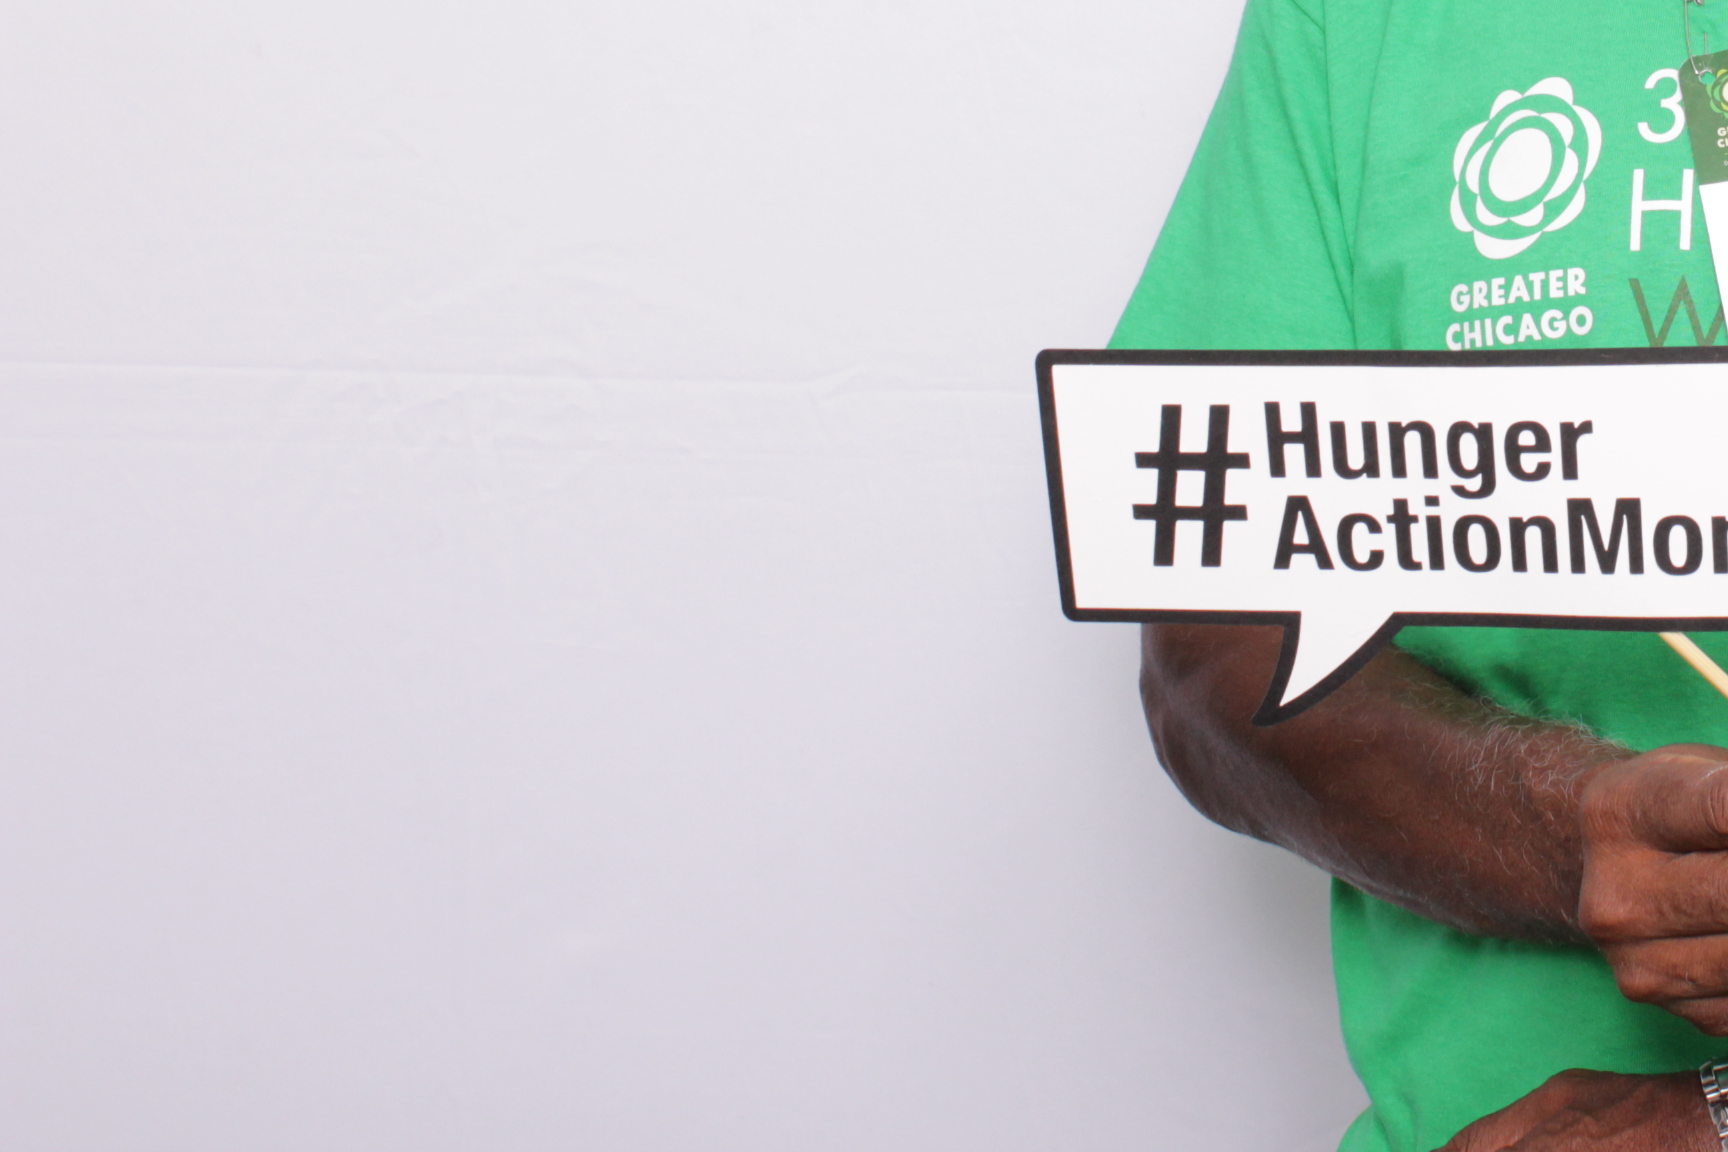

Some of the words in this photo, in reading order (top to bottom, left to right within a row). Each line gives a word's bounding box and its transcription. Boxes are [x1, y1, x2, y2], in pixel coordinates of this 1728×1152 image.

[1637, 68, 1687, 144] 3
[1450, 266, 1587, 313] GREATER
[1445, 305, 1594, 351] CHICAGO
